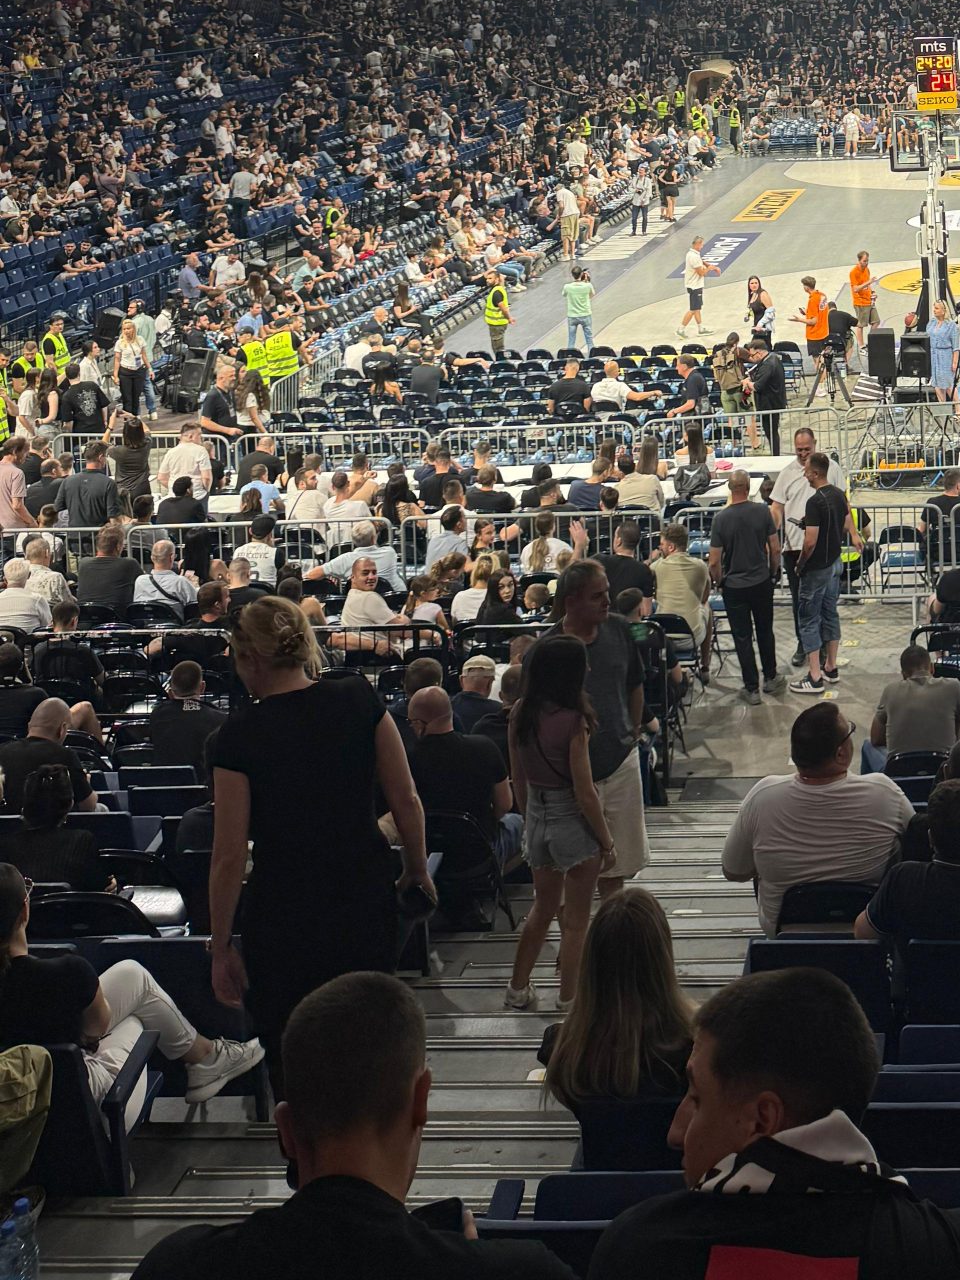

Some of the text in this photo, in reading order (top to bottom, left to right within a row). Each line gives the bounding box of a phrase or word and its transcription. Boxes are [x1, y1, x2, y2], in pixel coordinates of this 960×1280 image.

[920, 40, 947, 53] mts
[917, 56, 953, 70] 24:20
[931, 73, 955, 92] 24
[918, 95, 955, 106] SEIKO
